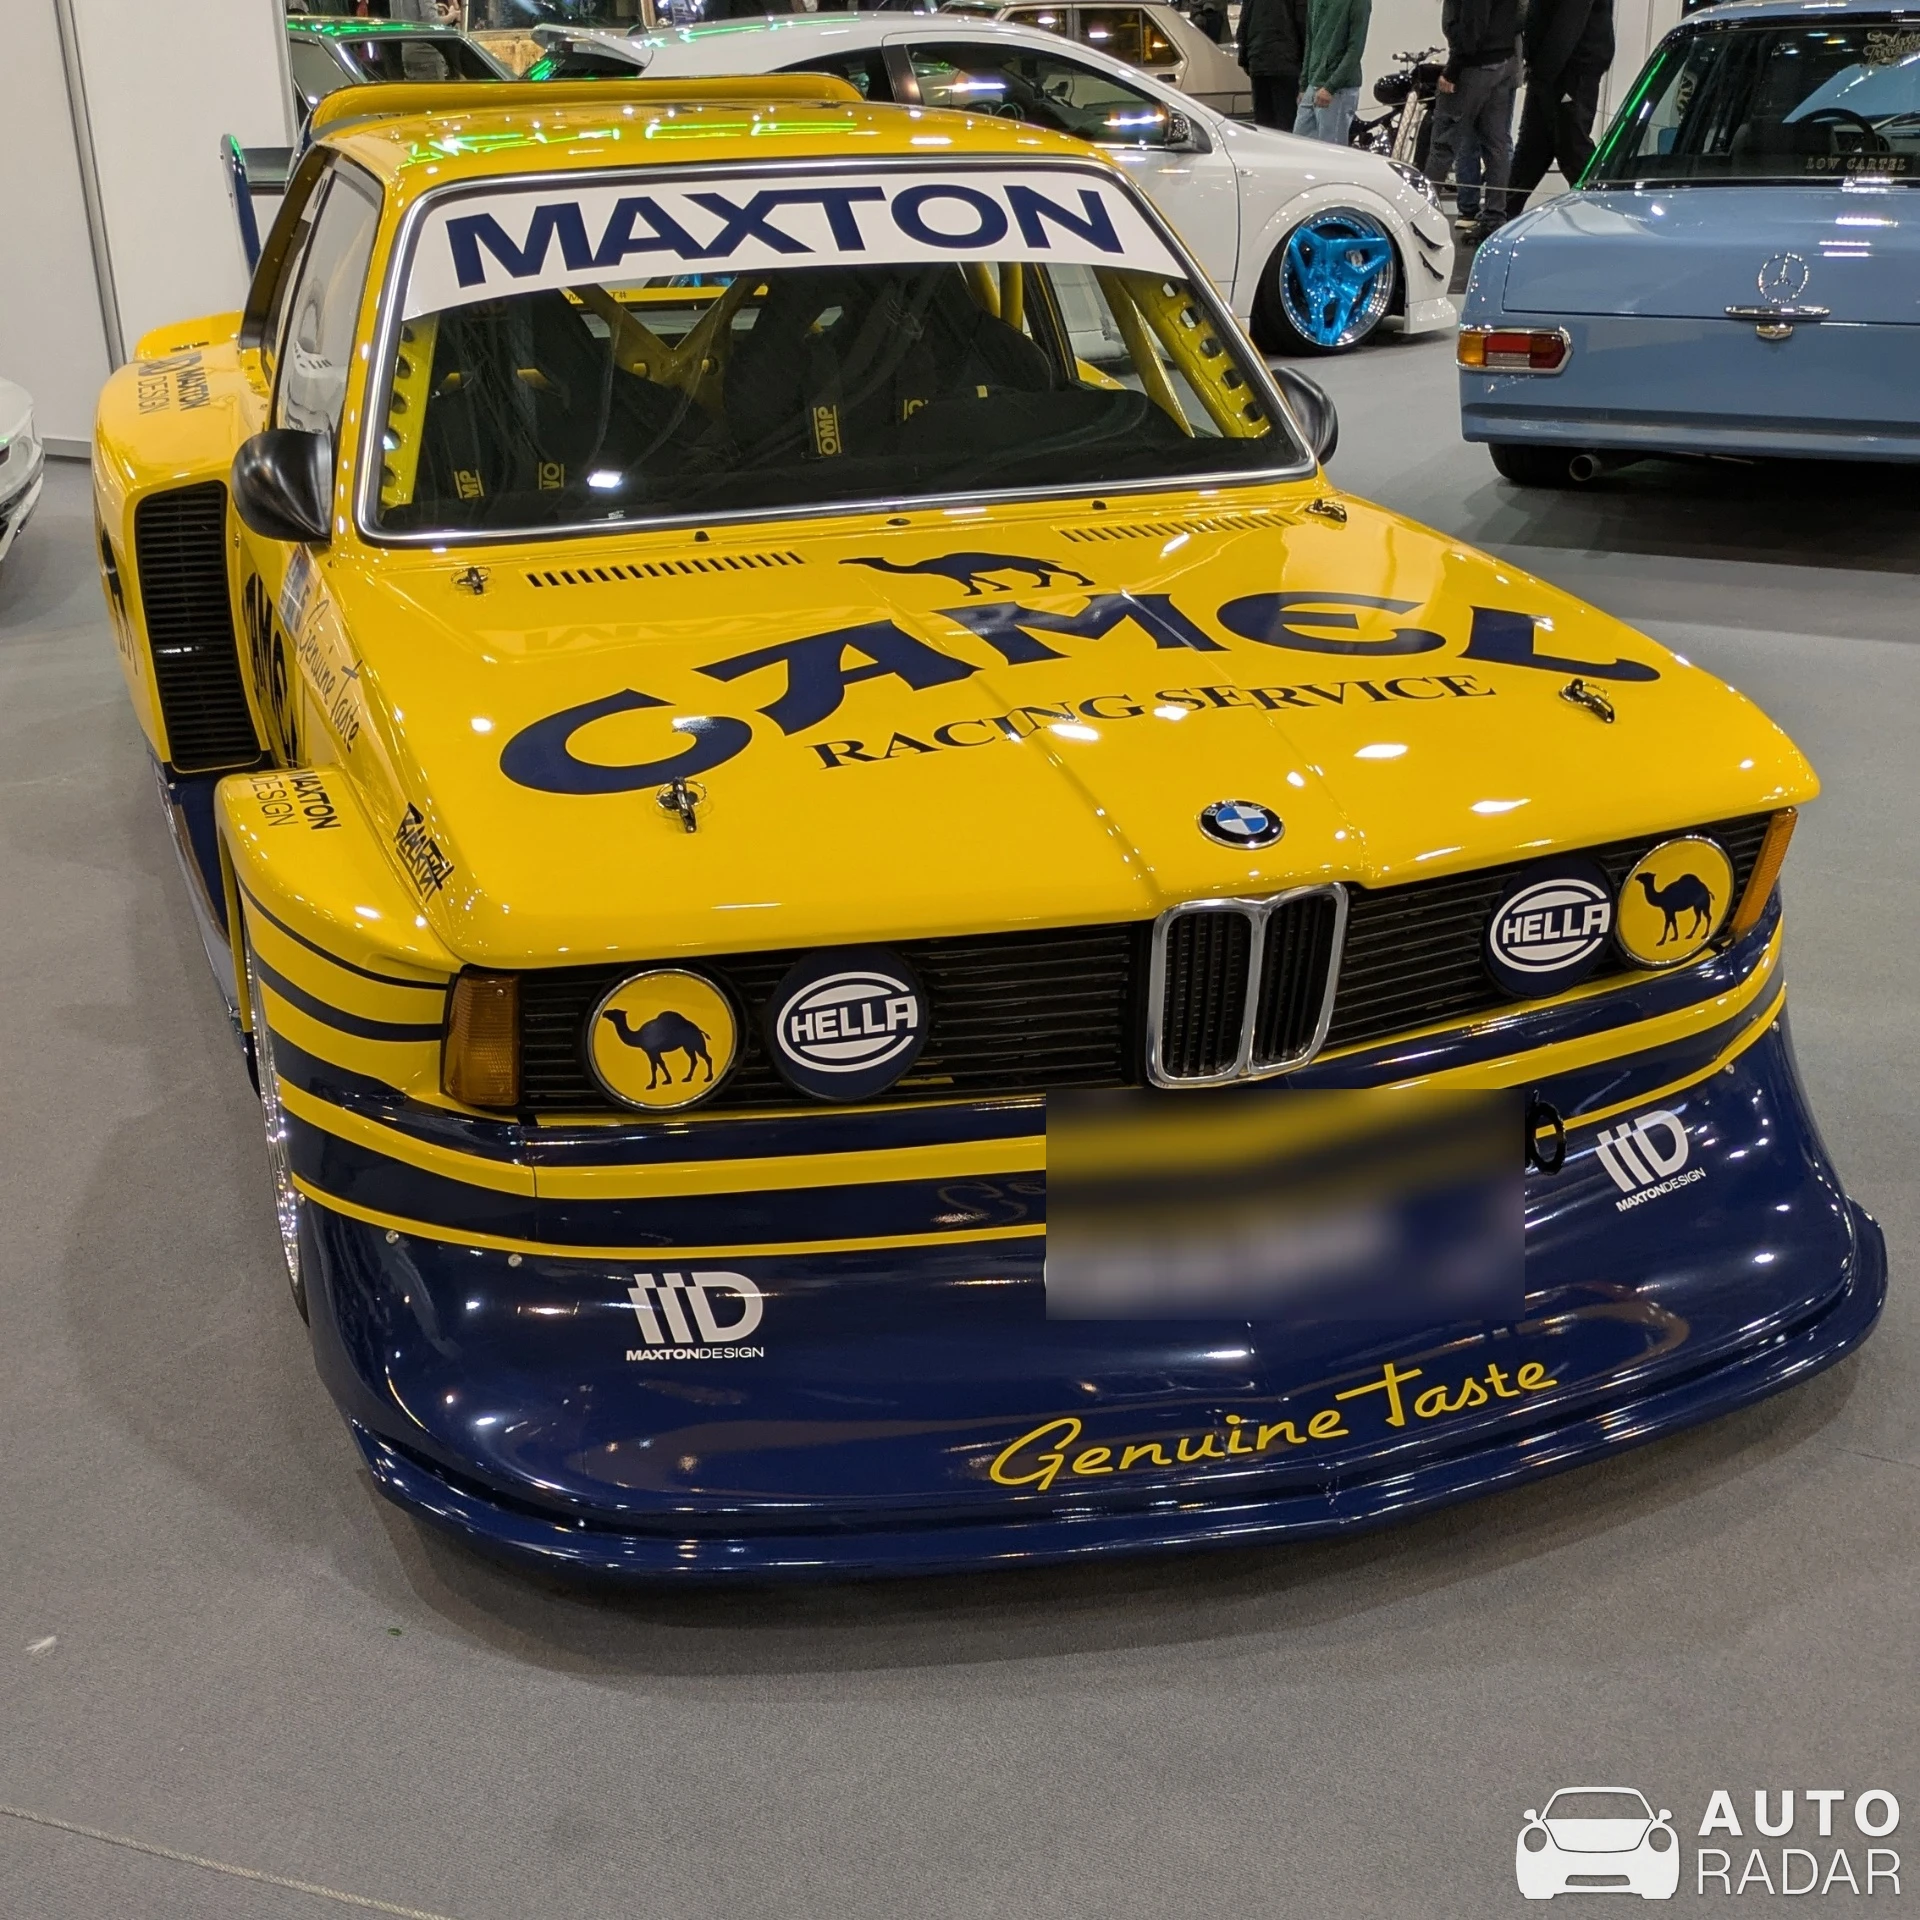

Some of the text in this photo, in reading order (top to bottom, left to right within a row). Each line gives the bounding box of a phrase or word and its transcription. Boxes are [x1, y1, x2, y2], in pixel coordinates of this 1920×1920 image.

[444, 184, 1125, 288] MAXTON
[815, 405, 838, 456] OMP
[500, 591, 1662, 796] CAMEL
[804, 673, 1497, 770] RACING SERVICE
[249, 774, 299, 827] DESIGN
[1501, 902, 1611, 945] HELLA
[791, 994, 919, 1044] HELLA
[989, 1362, 1558, 1491] Genuine Taste
